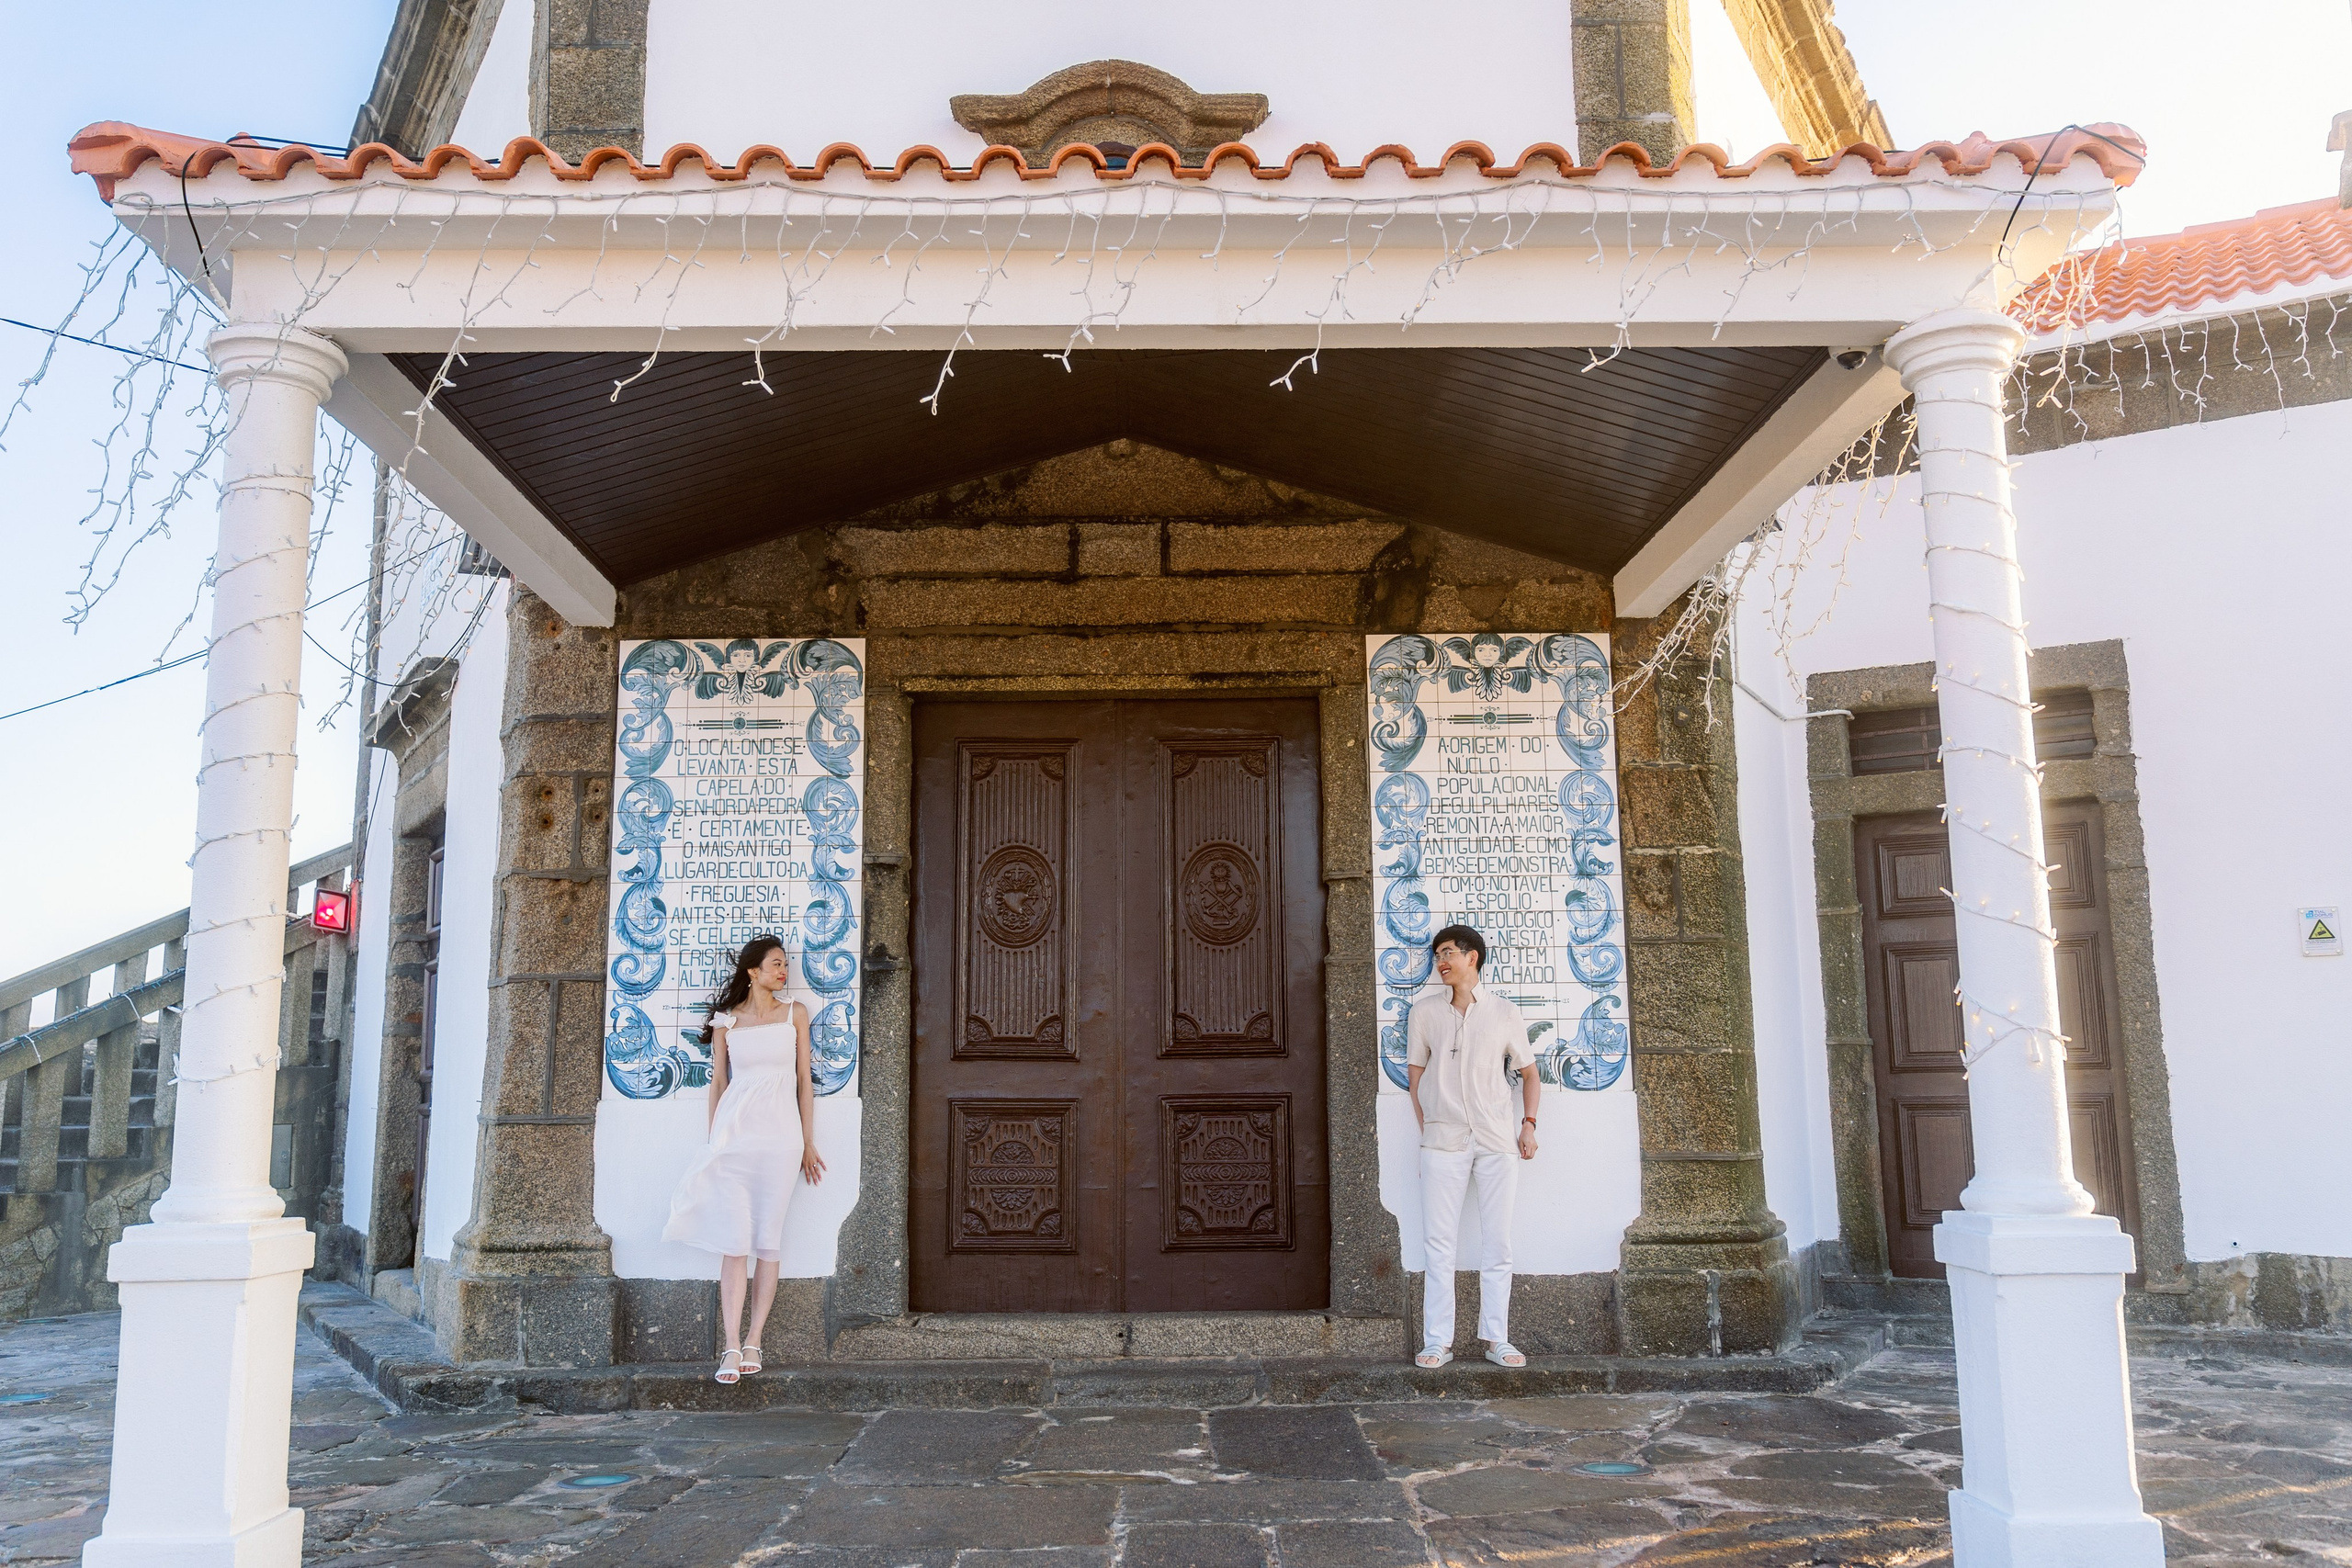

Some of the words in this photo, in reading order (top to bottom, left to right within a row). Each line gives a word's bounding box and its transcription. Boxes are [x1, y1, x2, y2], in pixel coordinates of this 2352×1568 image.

[674, 739, 684, 756] O
[688, 739, 740, 756] LOCAL
[741, 738, 784, 755] ONDE
[784, 737, 804, 755] SE
[1438, 737, 1448, 754] A
[1450, 737, 1507, 754] ORIGEM
[1521, 737, 1542, 753] DO
[677, 759, 746, 776] LEVANTA
[757, 758, 797, 775] ESTA
[696, 778, 760, 796] CAPELA
[764, 777, 785, 795] DO
[1437, 776, 1557, 795] POPULACIONAL
[673, 799, 736, 817] SENHOR
[738, 798, 756, 815] DA
[758, 797, 805, 815] PEDRA
[1430, 797, 1451, 814] DE
[1451, 795, 1559, 814] GULPILHARES
[672, 818, 682, 839] É
[699, 818, 807, 838] CERTAMENTE
[1426, 817, 1500, 834] REMONTA
[1503, 817, 1514, 833] A
[1517, 815, 1564, 833] MAIOR
[683, 841, 694, 859] O
[699, 840, 734, 857] MAIS
[734, 839, 791, 857] ANTIGO
[1423, 836, 1523, 855] ANTIGUIDADE
[1525, 837, 1567, 853] COMO
[664, 862, 717, 879] LUGAR
[718, 862, 735, 879] DE
[740, 861, 787, 879] CULTO
[790, 861, 808, 878] DA
[1425, 857, 1455, 874] BEM
[1457, 857, 1476, 874] SE
[1477, 856, 1570, 874] DEMONSTRA
[1439, 876, 1471, 893] COM
[1475, 876, 1485, 893] O
[1489, 875, 1558, 893] NOTAVEL
[691, 885, 780, 903] FREGUESIA
[1465, 893, 1532, 910] ESPOLIO
[671, 906, 726, 924] ANTES
[731, 906, 752, 924] DE
[760, 906, 800, 923] NELE
[669, 929, 690, 946] SE
[789, 926, 799, 943] A
[1498, 930, 1548, 947] NESTA
[1515, 947, 1547, 964] TEM
[1492, 965, 1555, 984] ACHADO
